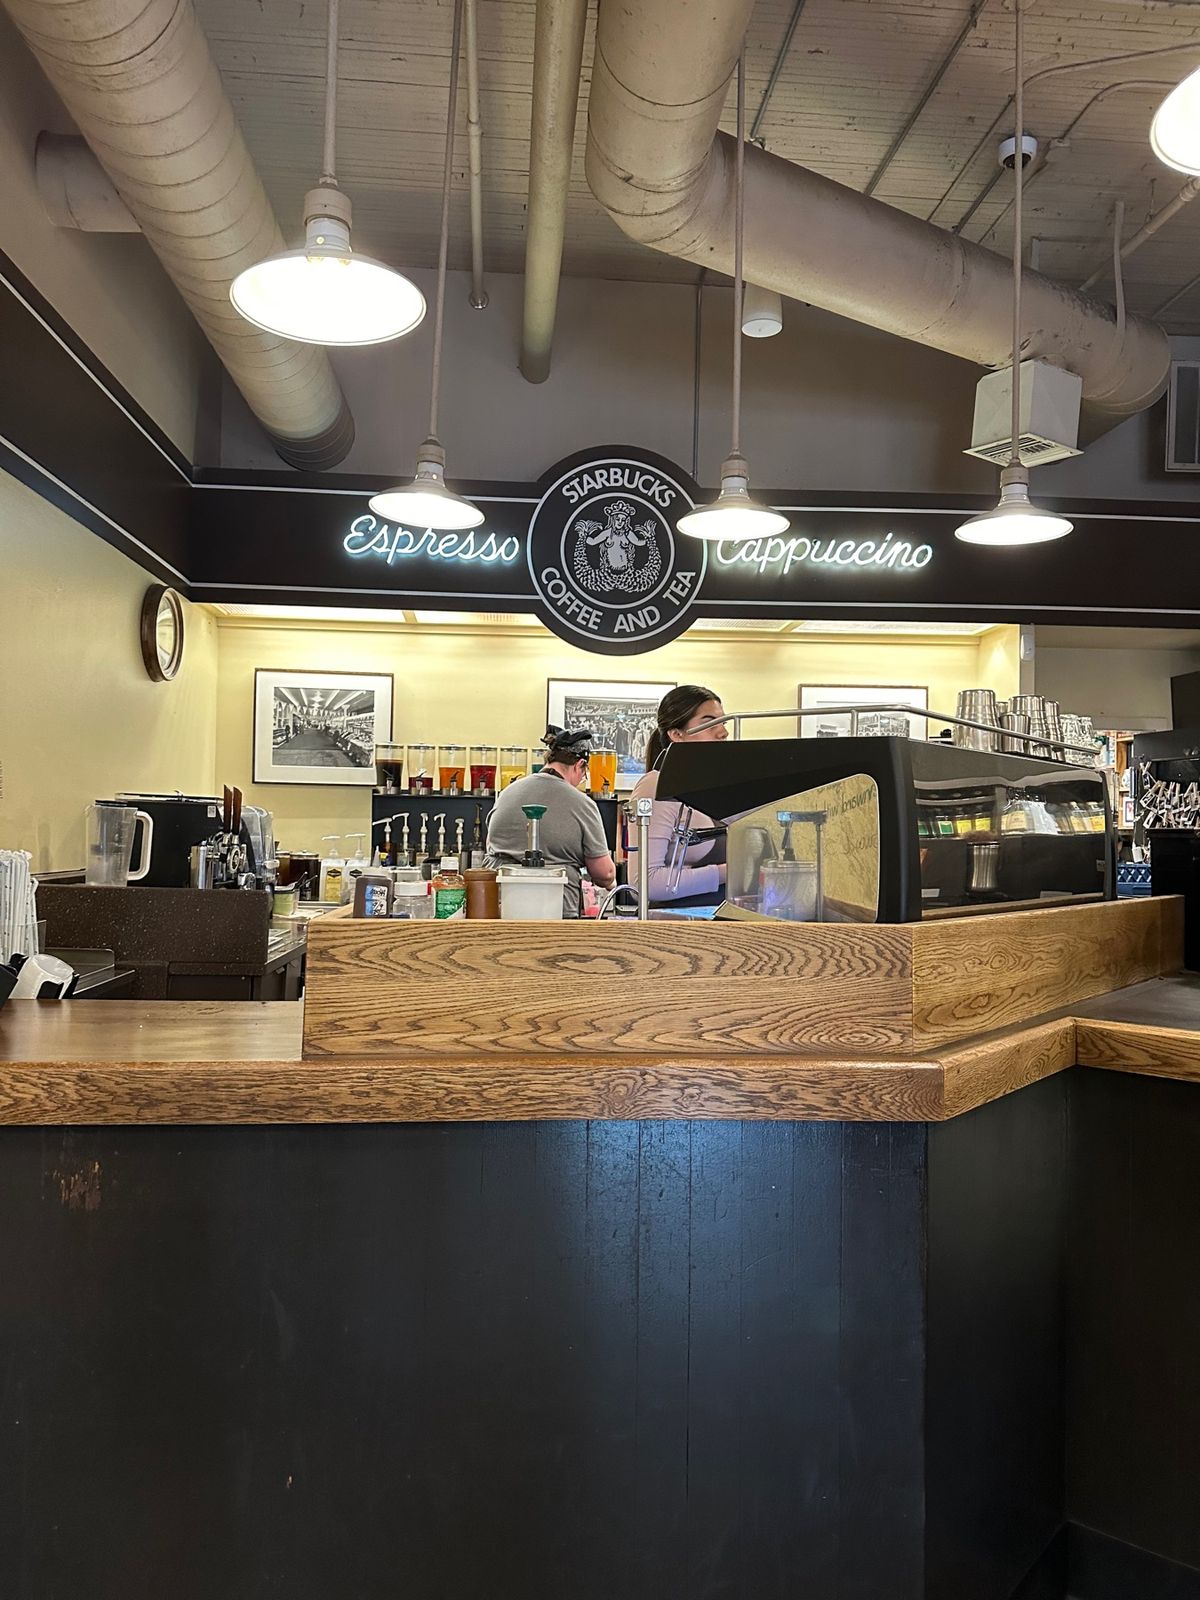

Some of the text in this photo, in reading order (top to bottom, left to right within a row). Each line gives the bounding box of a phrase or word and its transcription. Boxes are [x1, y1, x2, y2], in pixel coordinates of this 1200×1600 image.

[562, 467, 677, 508] STARBUCKS
[343, 514, 520, 564] Espresso
[716, 532, 933, 574] Cappuccino
[541, 566, 697, 633] COFFEE AND TEA
